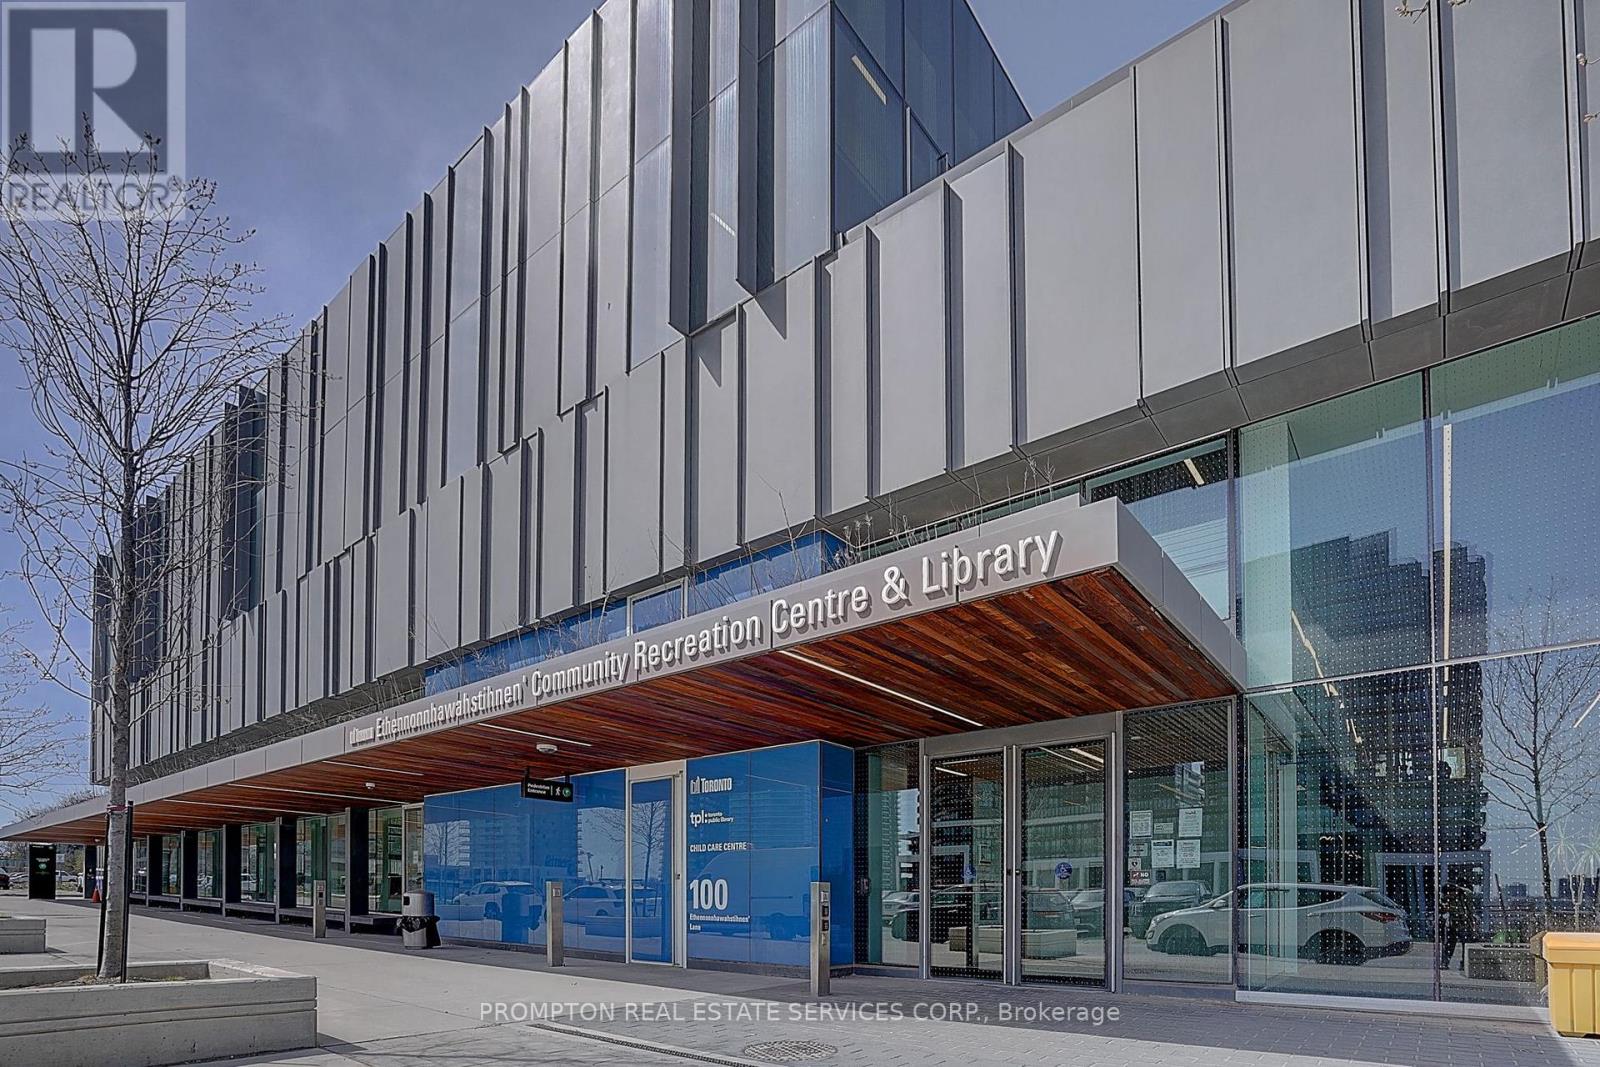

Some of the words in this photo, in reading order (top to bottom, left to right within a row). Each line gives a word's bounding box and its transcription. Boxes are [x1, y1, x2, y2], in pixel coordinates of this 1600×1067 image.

[532, 652, 630, 696] Community
[634, 615, 760, 670] Recreation
[772, 584, 868, 633] Centre
[881, 566, 909, 604] &
[922, 530, 1059, 594] Library
[690, 843, 706, 852] CHILD
[707, 842, 722, 851] CARE
[724, 841, 747, 850] CENTRE
[690, 878, 728, 910] 100
